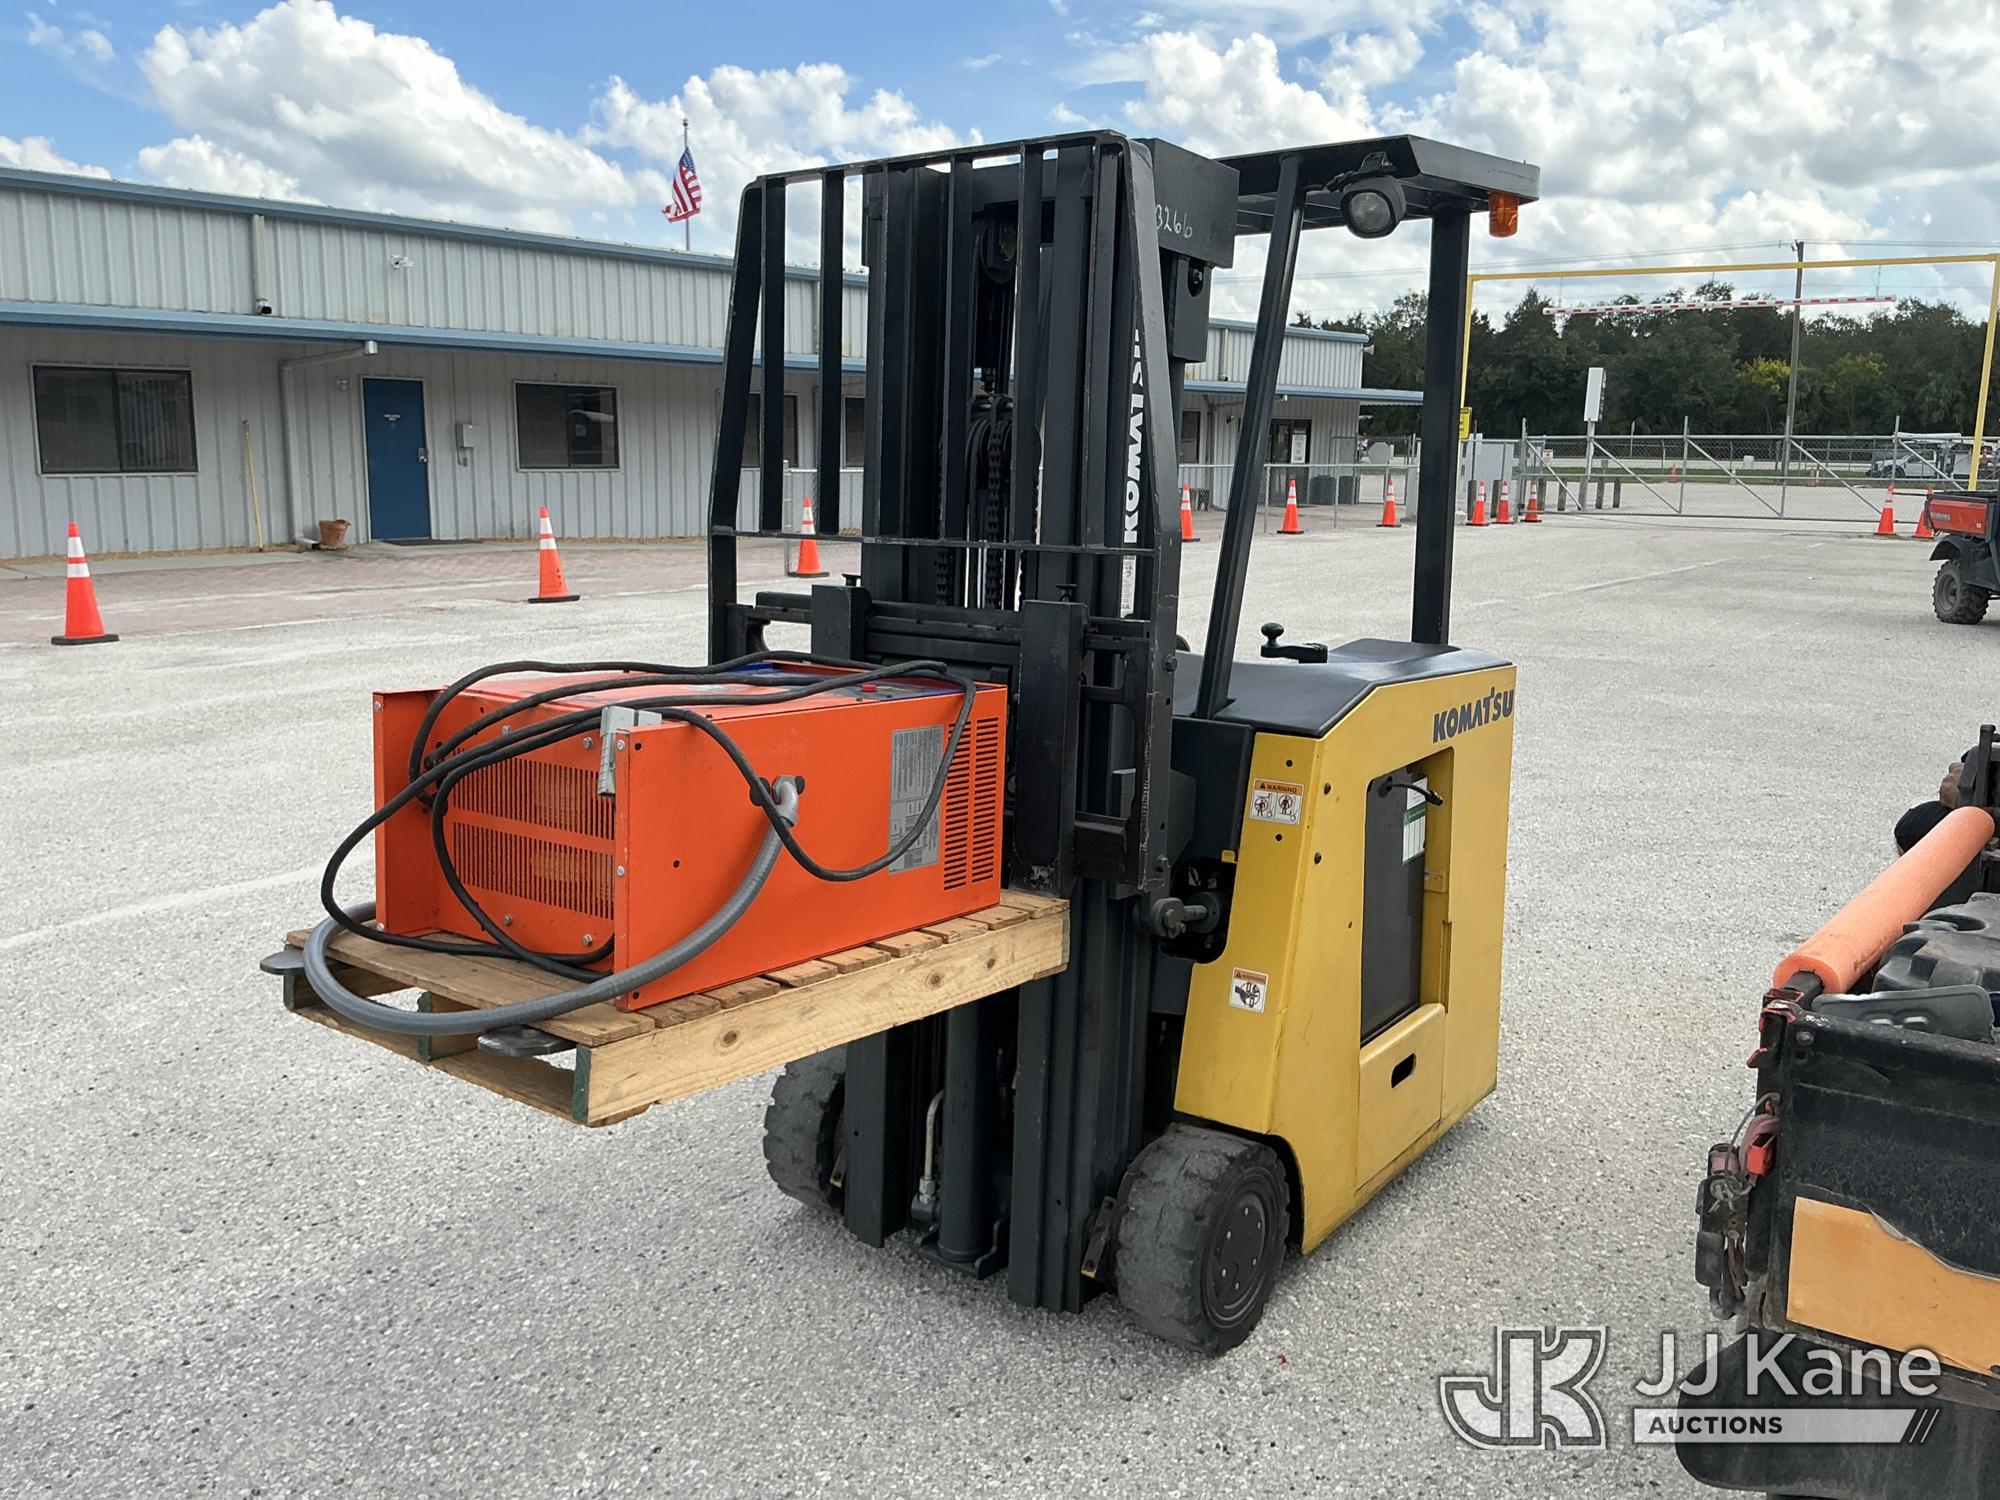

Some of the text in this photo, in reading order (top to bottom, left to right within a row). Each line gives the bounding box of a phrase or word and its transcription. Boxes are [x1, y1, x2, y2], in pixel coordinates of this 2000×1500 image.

[1155, 204, 1193, 239] 3266
[1432, 686, 1515, 744] KOMATSU
[1267, 783, 1298, 794] WARNING
